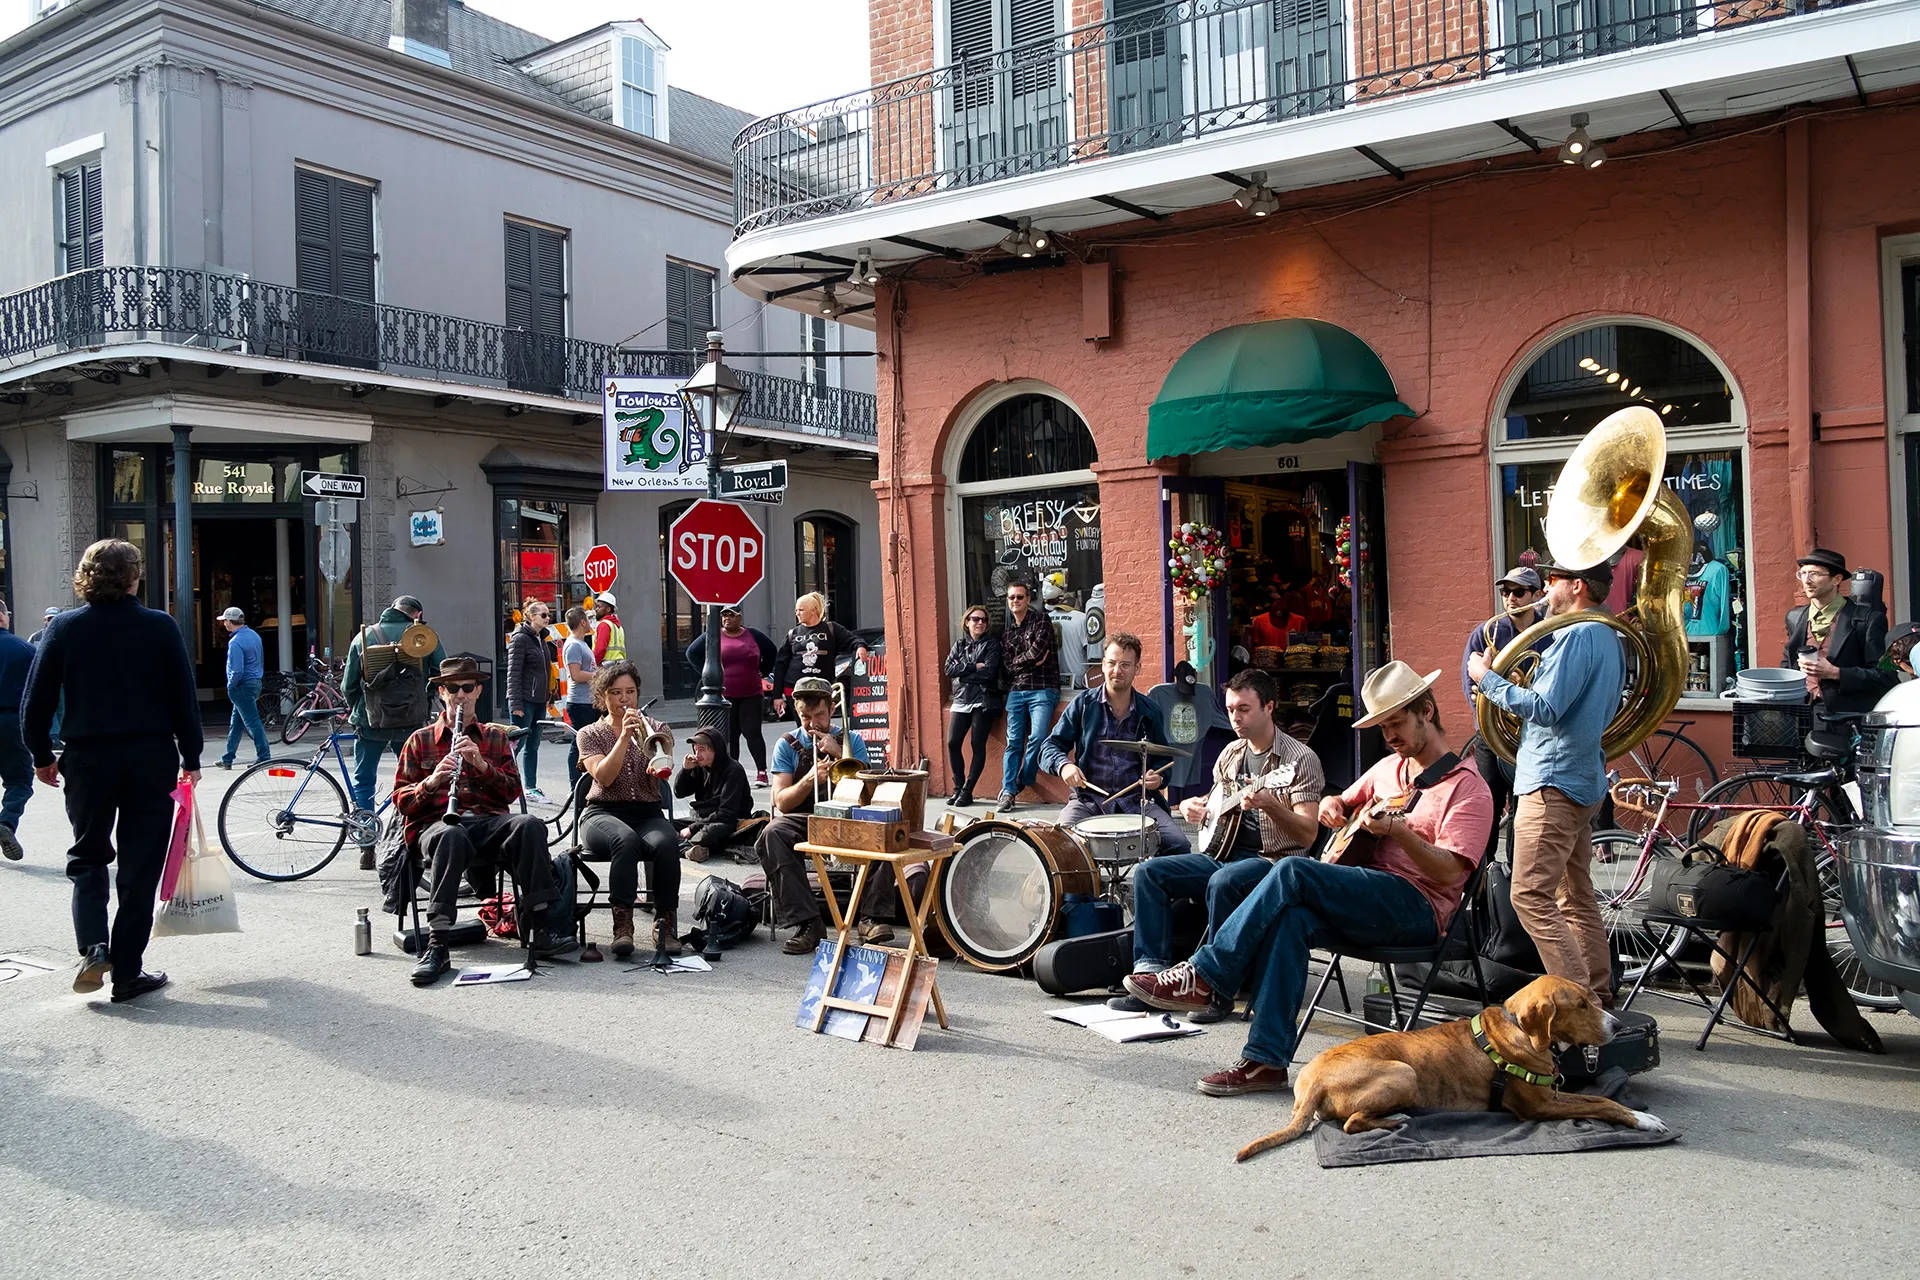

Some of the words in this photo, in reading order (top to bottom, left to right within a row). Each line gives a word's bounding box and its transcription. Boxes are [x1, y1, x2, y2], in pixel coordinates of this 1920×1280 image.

[618, 394, 678, 407] Toulouse
[1277, 456, 1299, 469] 601
[223, 465, 246, 478] 541
[321, 479, 338, 490] ONE
[341, 480, 359, 491] WAY
[612, 478, 634, 486] New
[682, 478, 693, 486] To
[695, 478, 708, 486] Go
[734, 471, 773, 491] Royal
[1664, 474, 1722, 491] TIMES
[193, 481, 223, 494] Rue
[227, 481, 276, 497] Royale
[1075, 527, 1100, 539] SUNDAY
[677, 531, 758, 573] STOP
[586, 558, 615, 580] STOP
[795, 632, 828, 643] GUCCI
[872, 685, 885, 696] SOLD
[191, 894, 224, 909] Street
[848, 947, 887, 964] SKINNY
